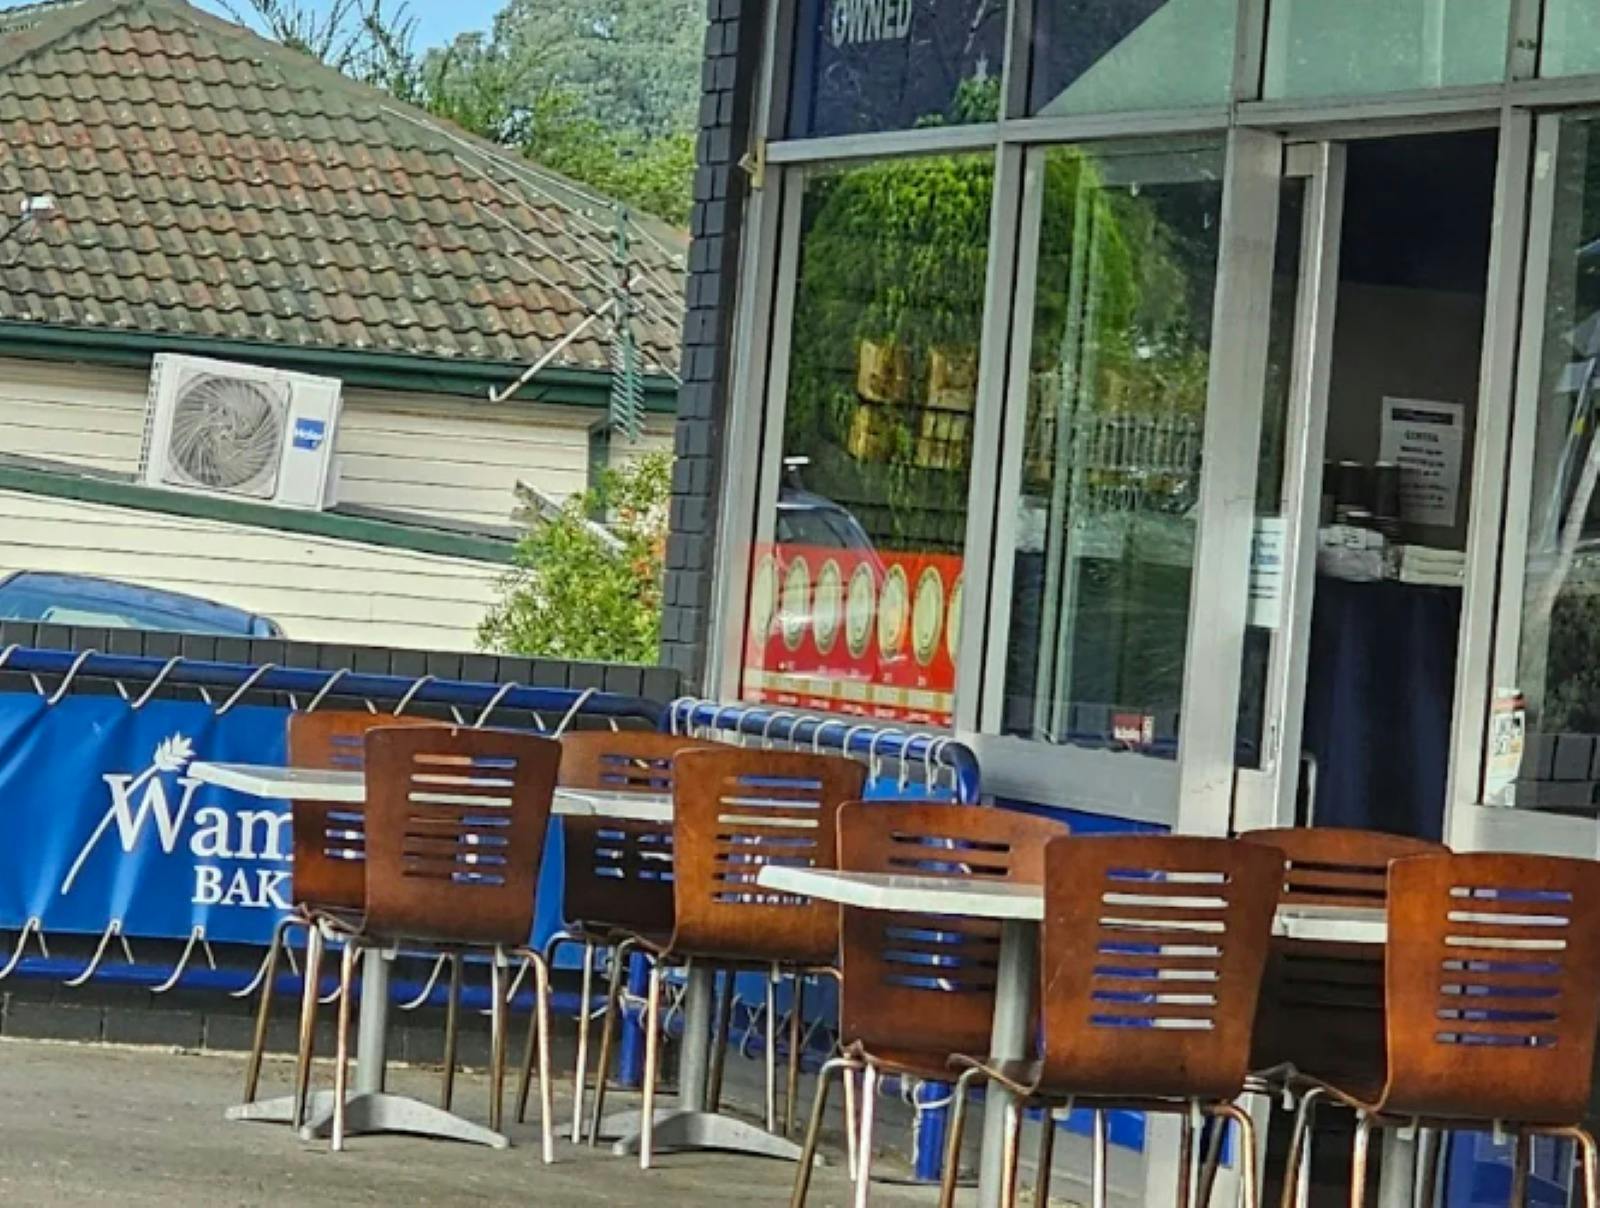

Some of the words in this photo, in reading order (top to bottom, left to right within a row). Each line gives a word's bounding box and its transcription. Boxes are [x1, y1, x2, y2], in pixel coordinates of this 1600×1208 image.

[831, 0, 912, 48] OWNED
[102, 773, 294, 861] Wam
[191, 865, 294, 910] BAK
